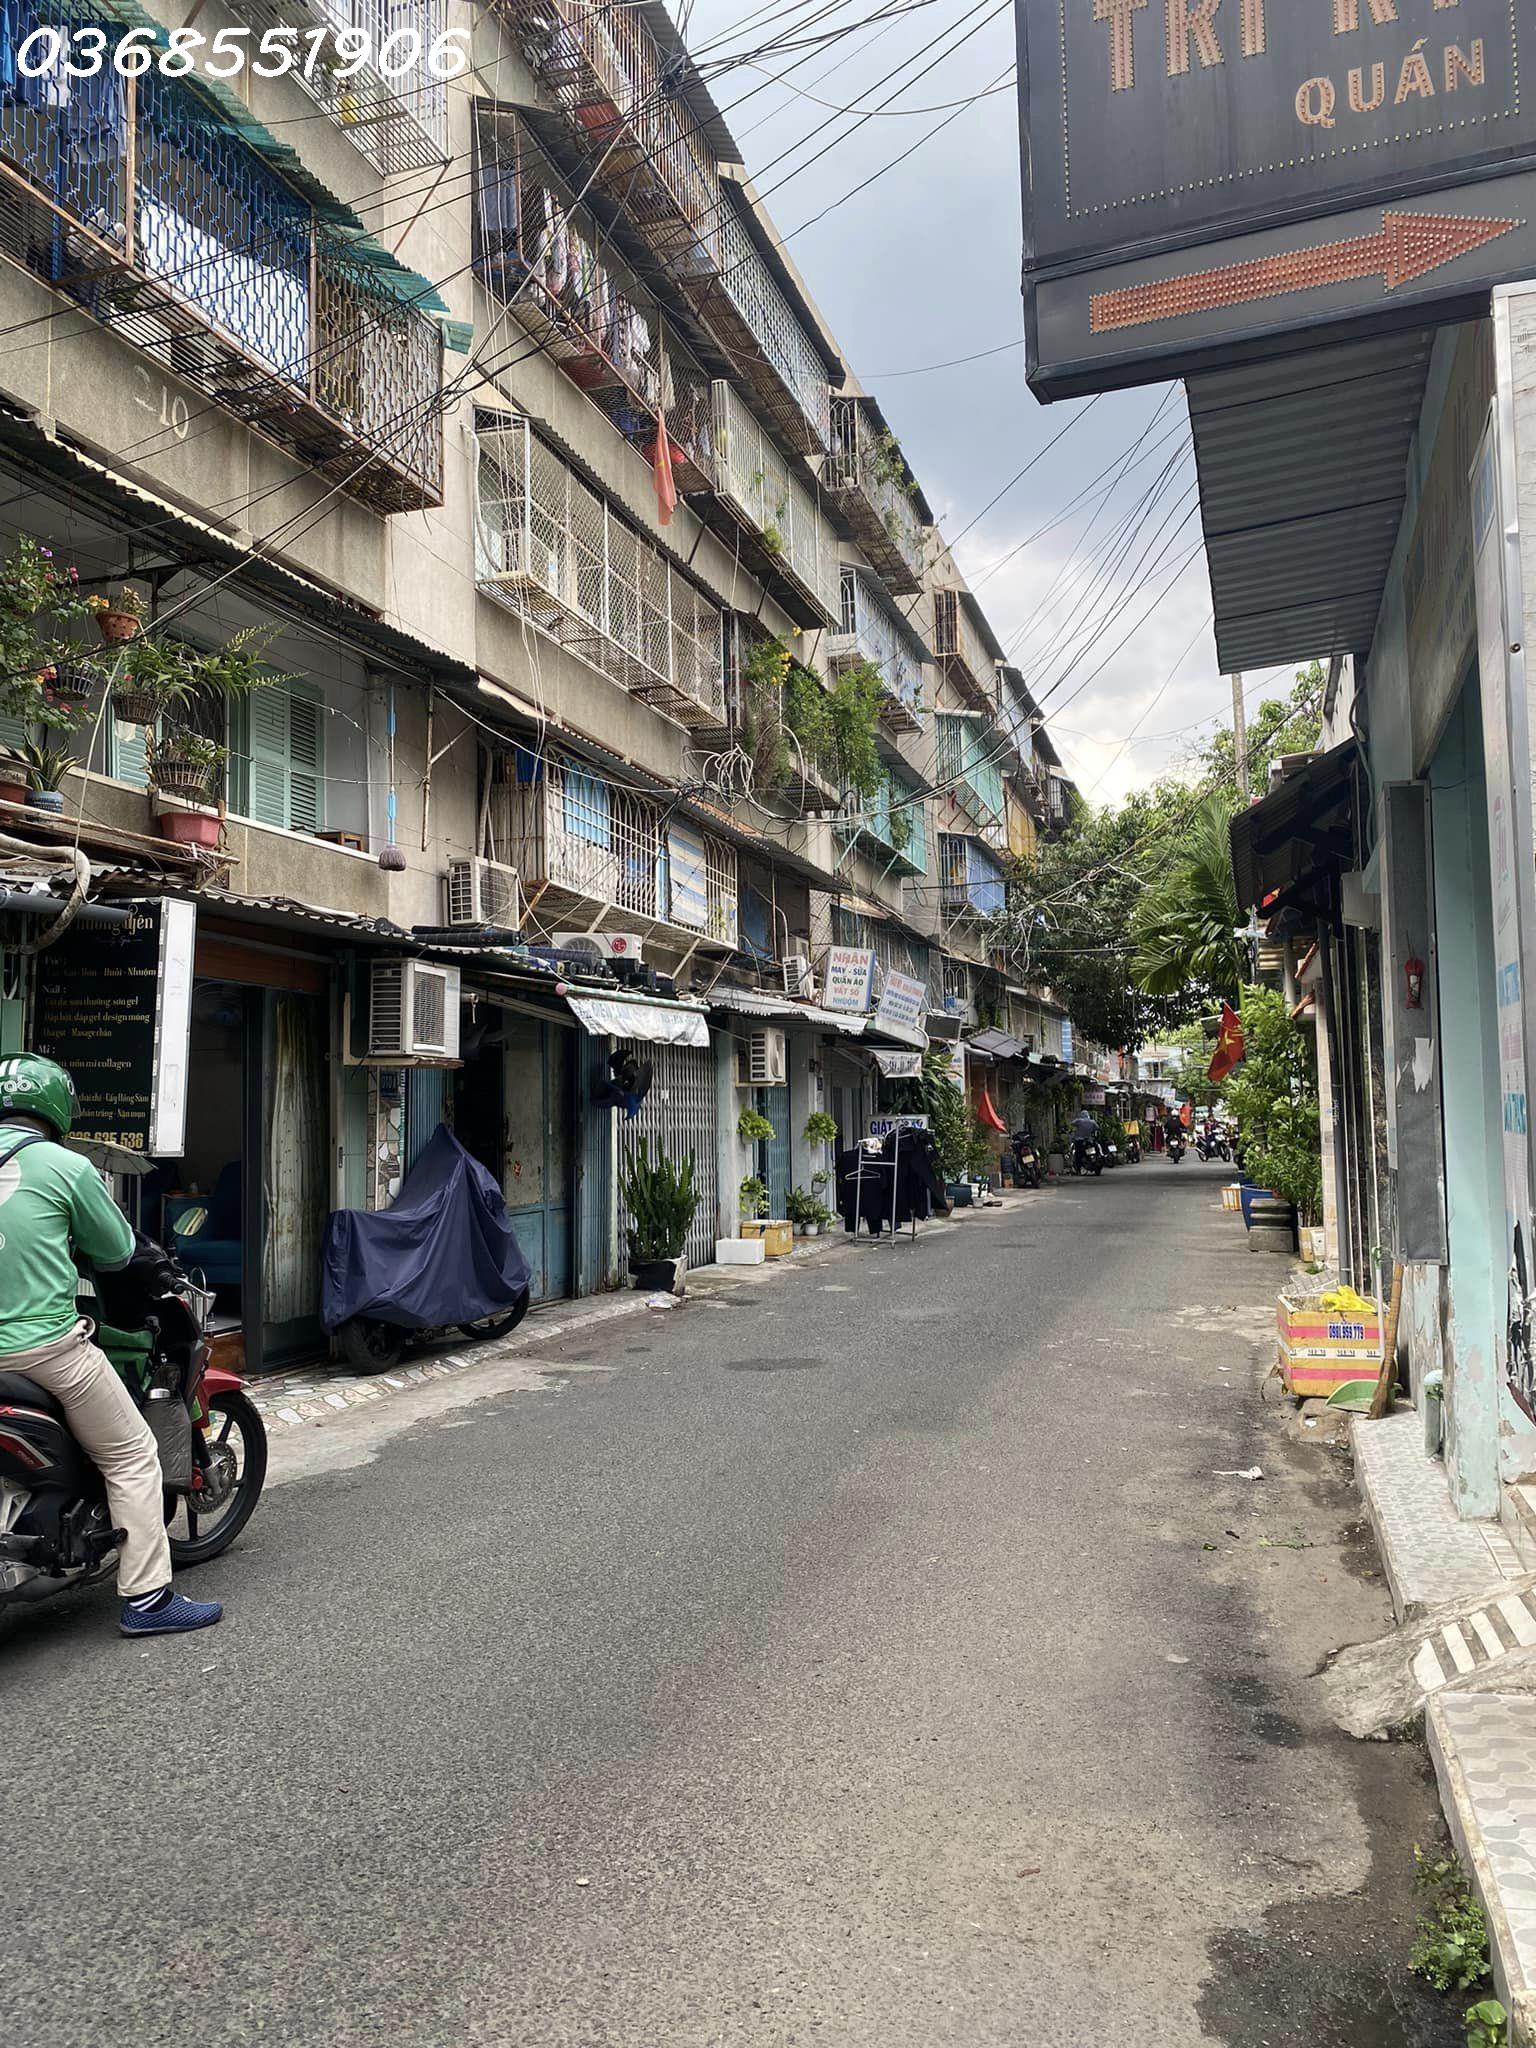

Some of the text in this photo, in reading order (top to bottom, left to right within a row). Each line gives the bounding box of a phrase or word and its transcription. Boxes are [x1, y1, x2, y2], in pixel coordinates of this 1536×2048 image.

[1295, 37, 1485, 128] QUÁN
[832, 951, 869, 966] NHẬN
[97, 1057, 132, 1071] collagen
[120, 1132, 144, 1149] 536
